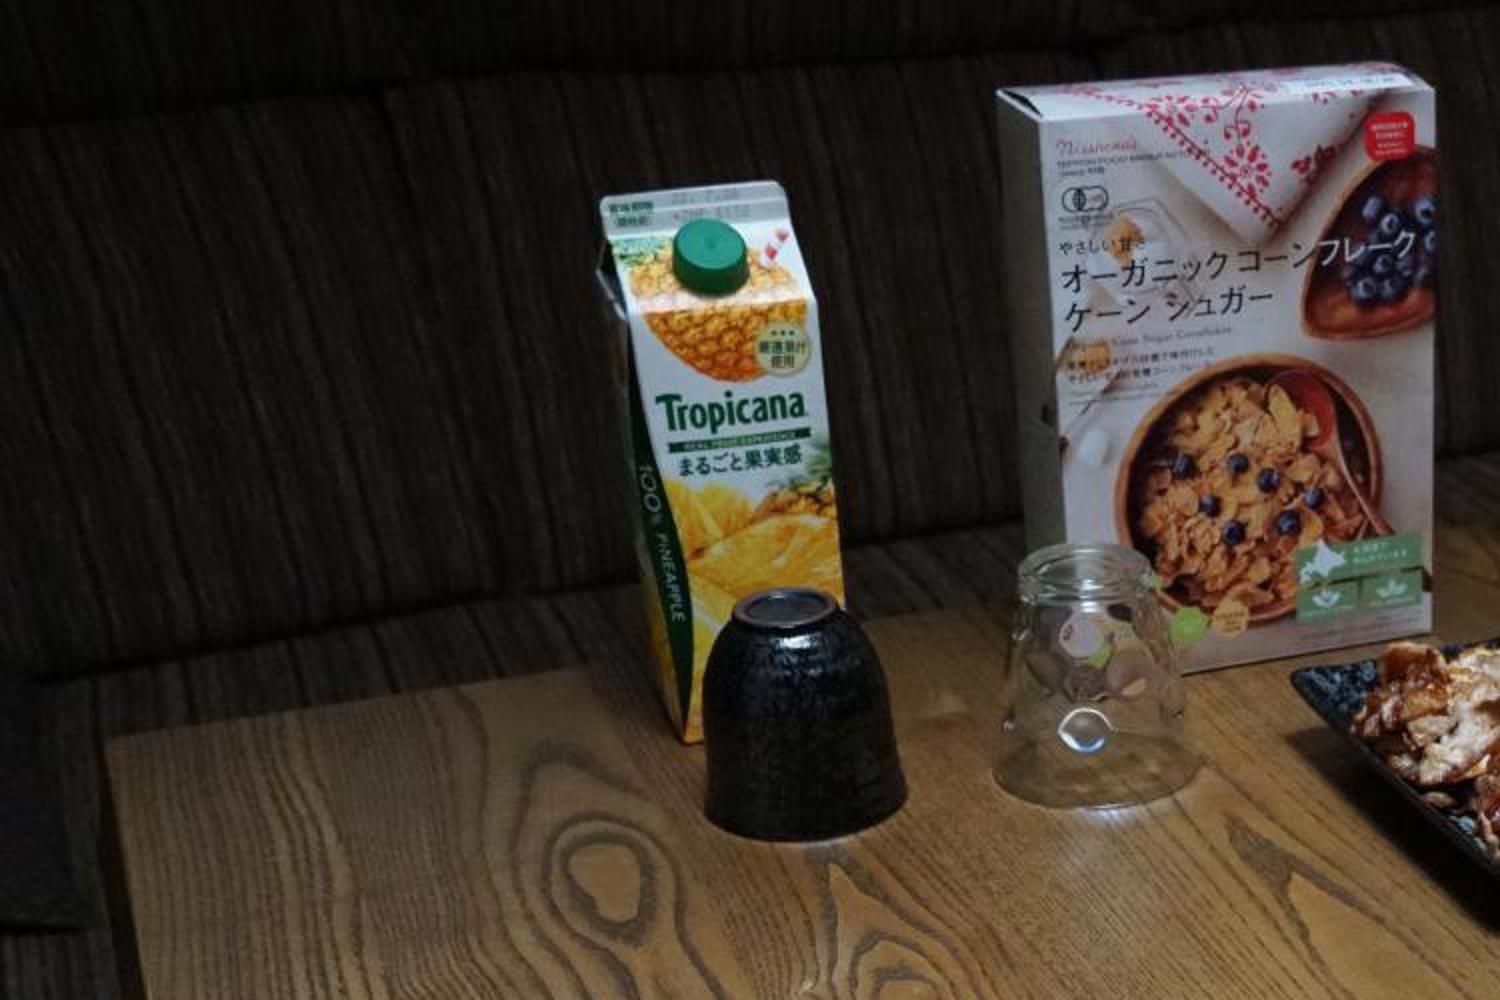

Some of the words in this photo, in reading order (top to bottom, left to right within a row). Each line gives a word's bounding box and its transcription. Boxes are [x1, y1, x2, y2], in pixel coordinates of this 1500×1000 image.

[655, 390, 806, 435] Tropicana
[679, 443, 803, 477] まるごと果実感
